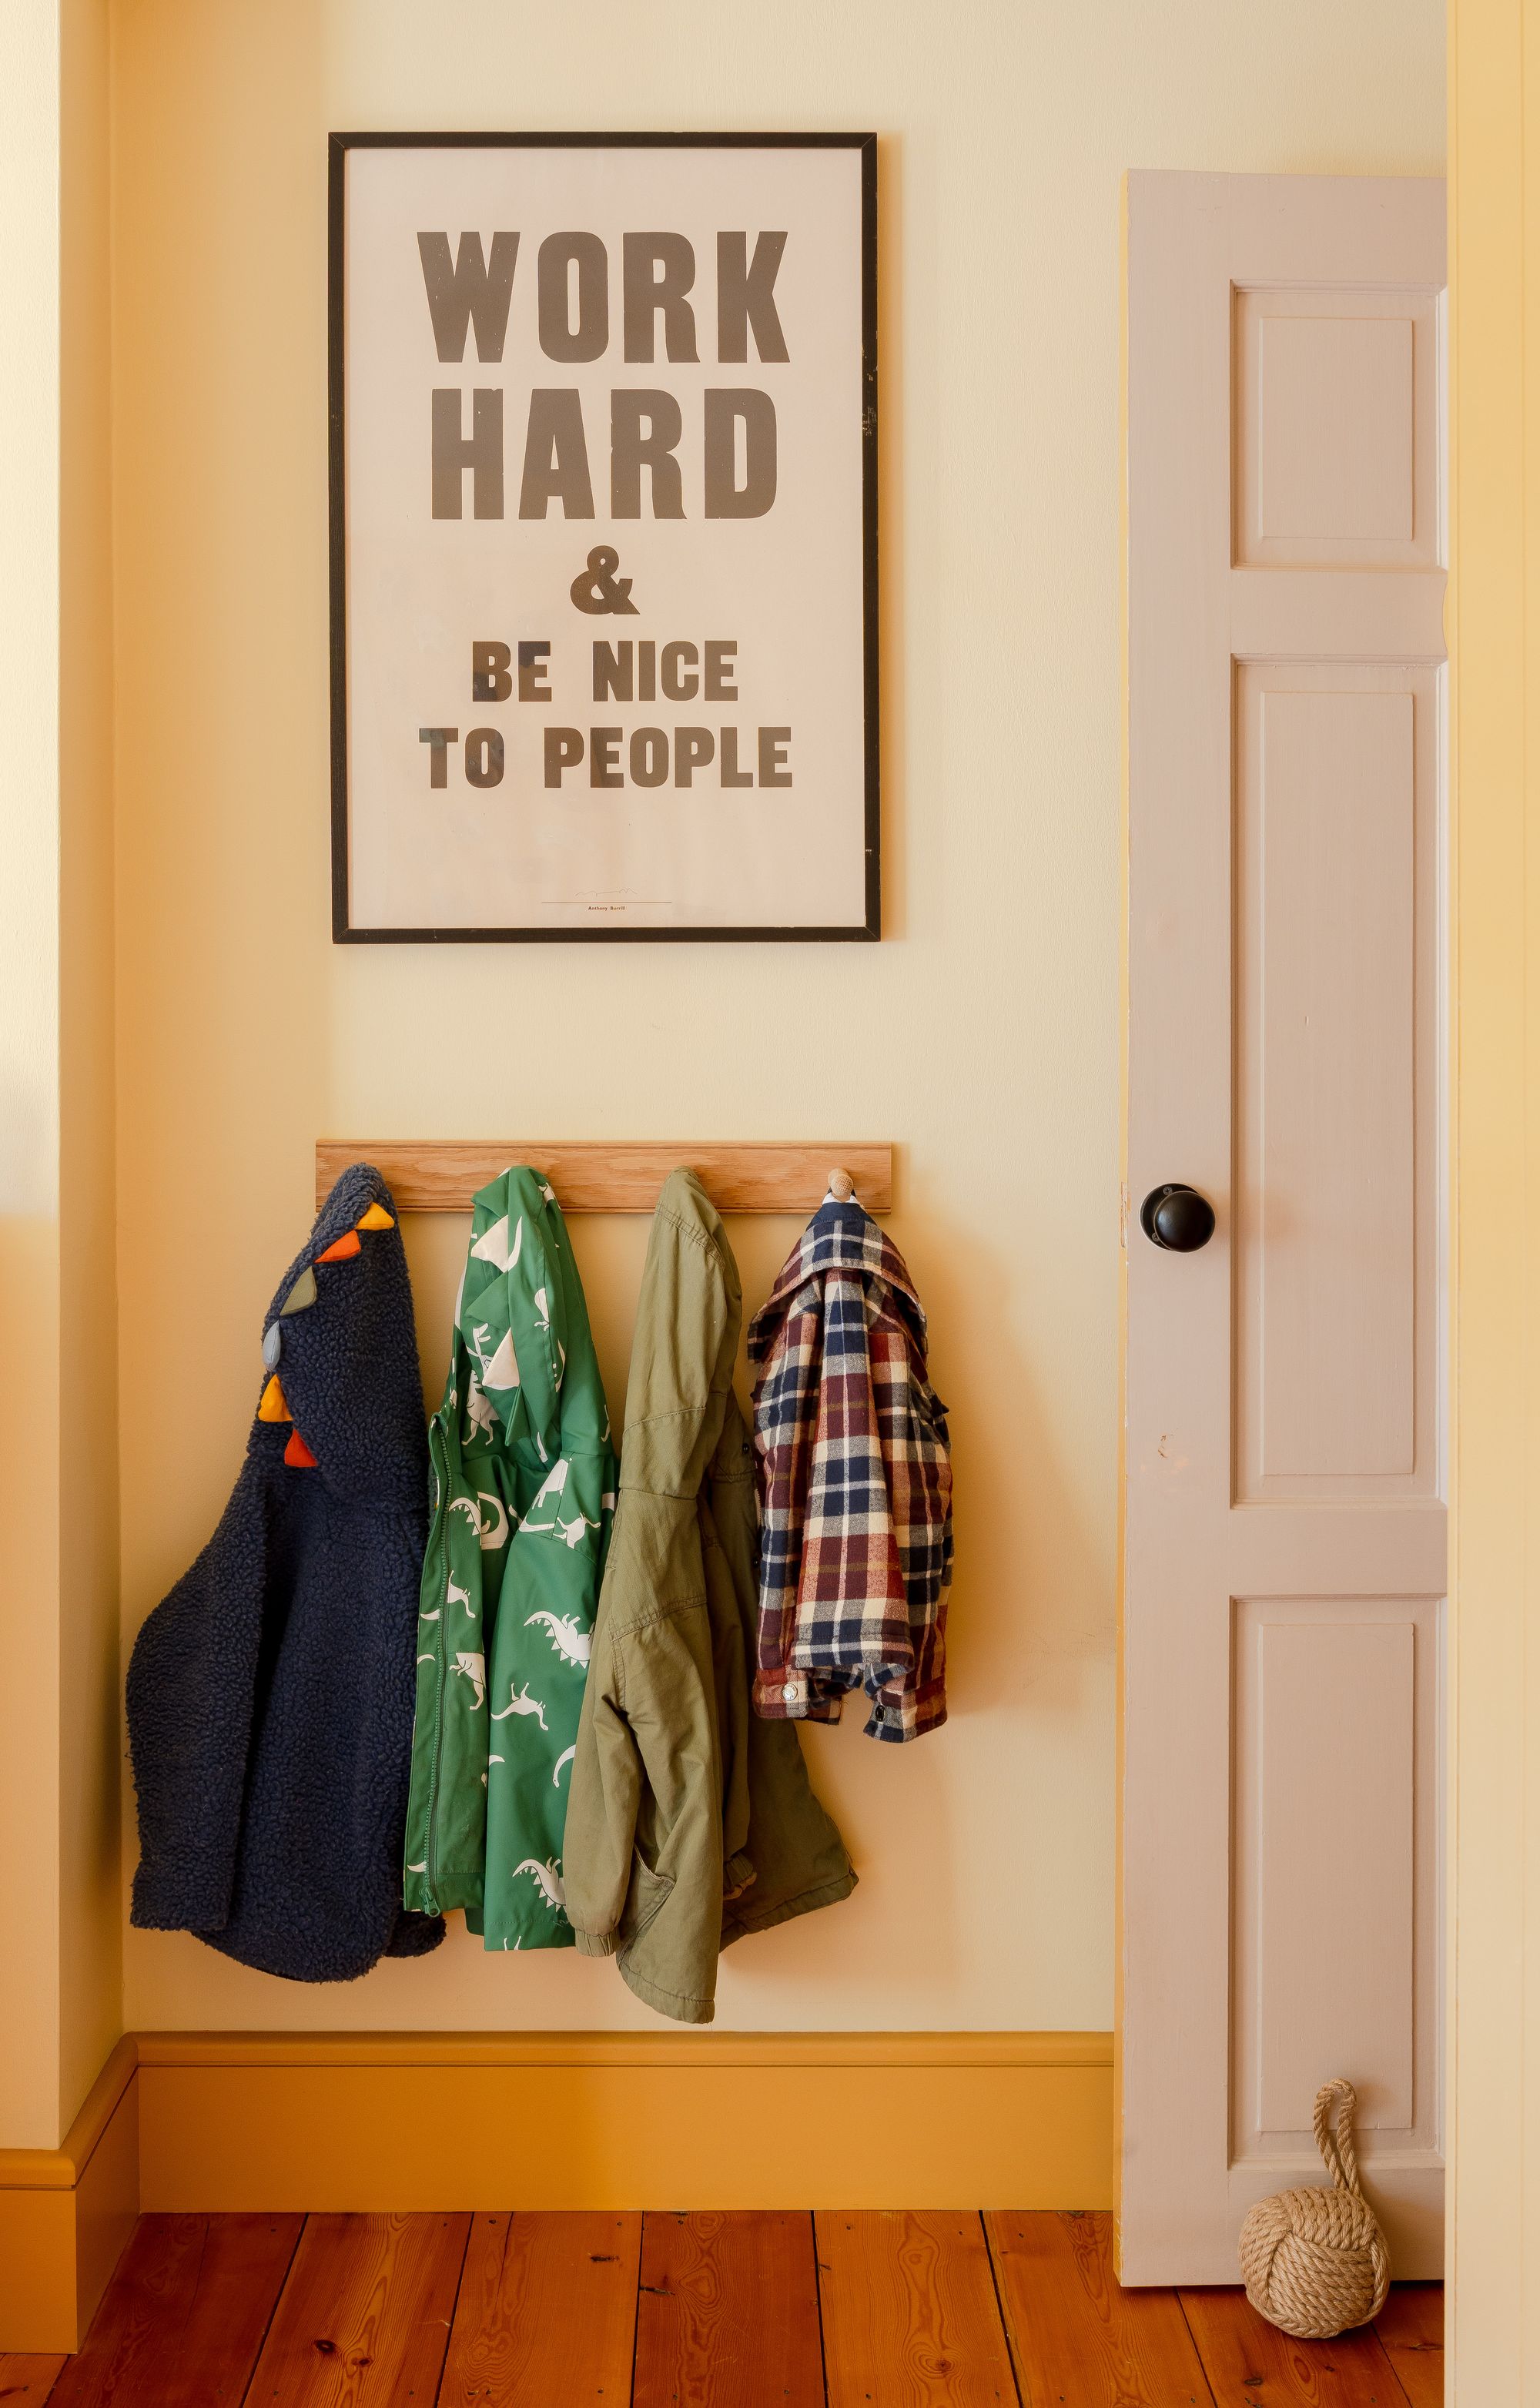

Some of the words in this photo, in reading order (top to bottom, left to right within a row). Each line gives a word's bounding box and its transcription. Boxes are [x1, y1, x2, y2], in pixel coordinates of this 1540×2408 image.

[417, 230, 791, 363] WORK
[431, 388, 778, 520] HARD
[570, 544, 641, 615] &
[472, 640, 552, 702] BE
[592, 640, 738, 702] NICE
[418, 726, 505, 789] TO
[544, 726, 793, 789] PEOPLE
